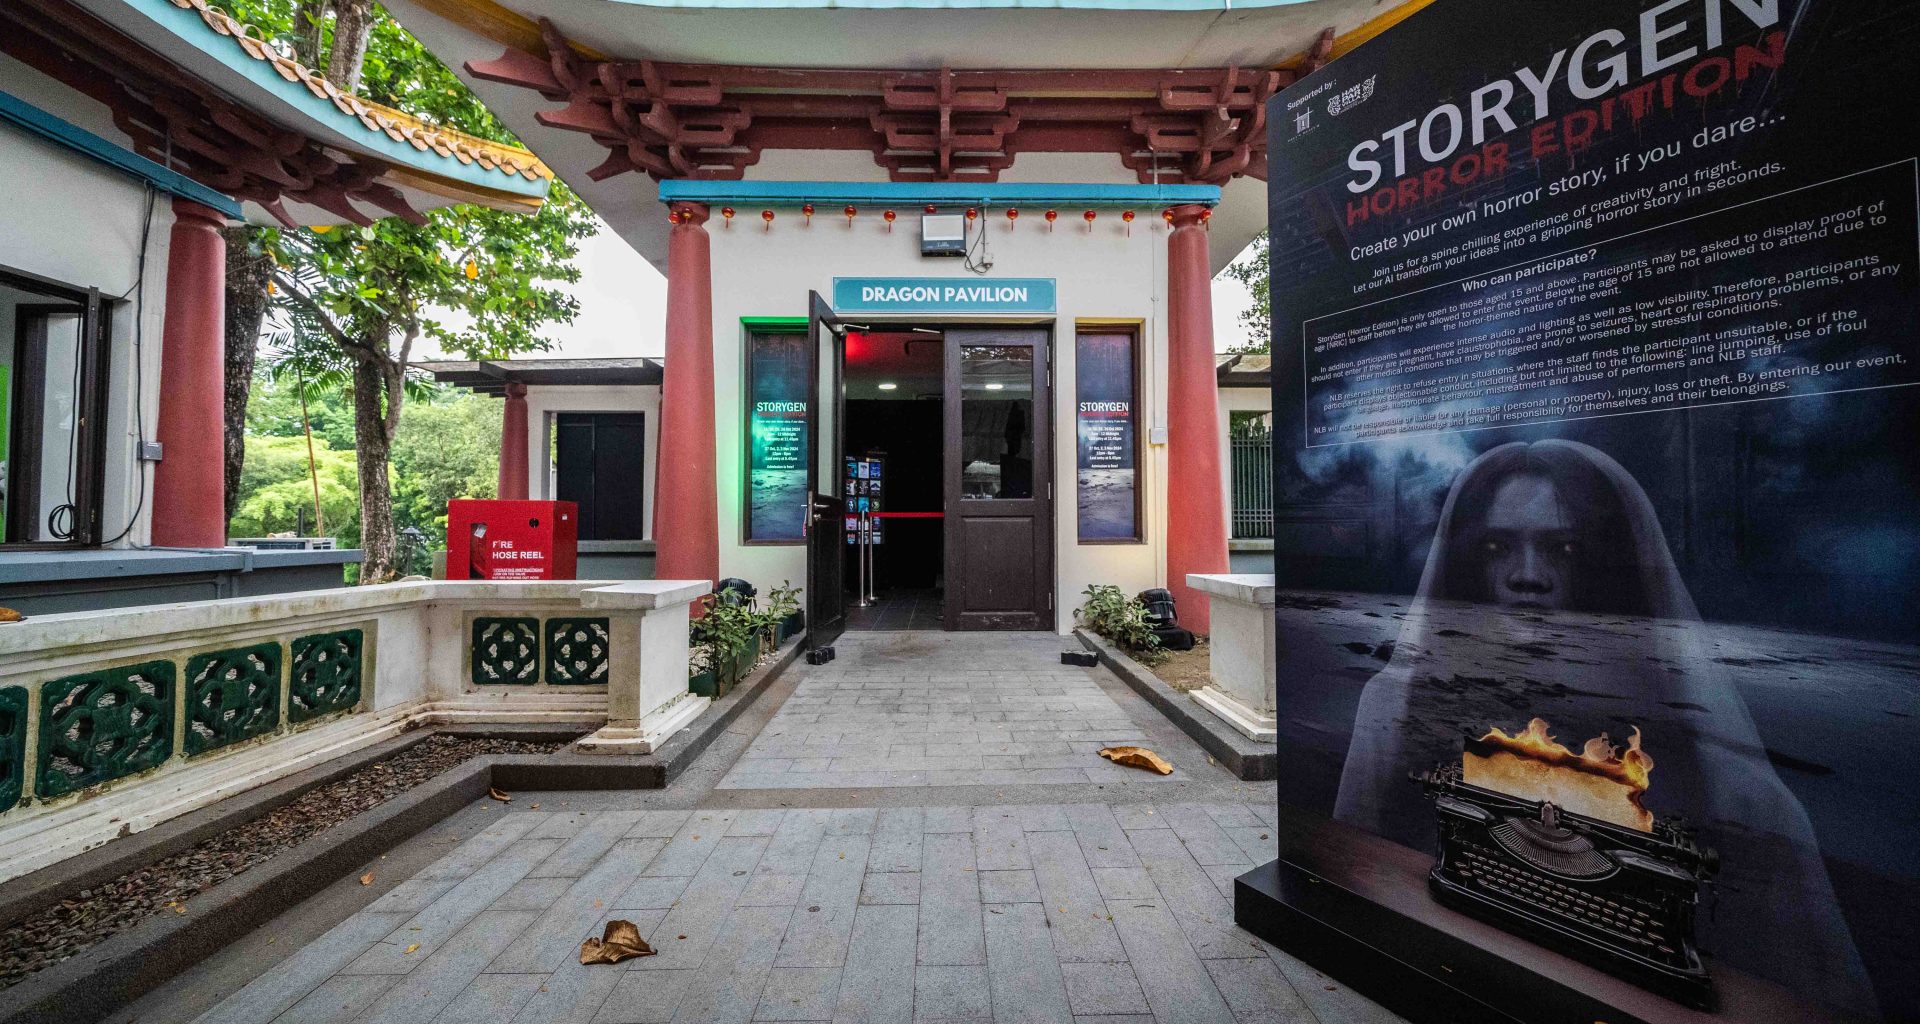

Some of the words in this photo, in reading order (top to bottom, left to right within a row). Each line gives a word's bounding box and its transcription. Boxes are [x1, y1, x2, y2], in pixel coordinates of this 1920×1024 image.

[1287, 85, 1322, 110] Supported
[1324, 81, 1333, 90] by
[1342, 83, 1360, 98] HAW
[1342, 89, 1360, 103] PAR
[1346, 142, 1510, 227] HORROR
[1530, 31, 1786, 162] EDITION
[1351, 236, 1397, 261] Create
[1403, 222, 1437, 248] your
[1442, 209, 1475, 231] own
[1484, 187, 1542, 217] horror
[1549, 167, 1606, 196] story,
[1616, 152, 1629, 174] if
[1638, 140, 1680, 172] you
[1692, 111, 1785, 149] dare...
[1353, 282, 1366, 294] Let
[1368, 279, 1383, 289] our
[1384, 273, 1393, 285] AI
[1396, 262, 1441, 281] transform
[1445, 254, 1467, 270] your
[1470, 245, 1499, 260] ideas
[1503, 237, 1525, 250] into
[1529, 234, 1536, 243] a
[1541, 218, 1592, 242] gripping
[1597, 204, 1639, 223] horror
[1644, 191, 1681, 210] story
[1688, 184, 1700, 197] in
[1707, 161, 1785, 191] seconds.
[1372, 266, 1390, 278] Join
[1393, 263, 1404, 272] us
[1406, 258, 1420, 268] for
[1422, 255, 1428, 263] a
[1431, 246, 1458, 261] spine
[1462, 233, 1500, 251] chilling
[1503, 212, 1568, 239] experience
[1573, 204, 1586, 218] of
[1590, 186, 1654, 212] creativity
[1659, 172, 1688, 192] and
[1694, 158, 1741, 182] fright.
[1317, 332, 1345, 344] StoryGen
[1347, 326, 1370, 339] (Horror
[1372, 318, 1399, 331] Edition)
[1409, 312, 1425, 322] only
[1427, 308, 1446, 319] open
[1460, 299, 1483, 310] those
[1486, 291, 1506, 306] aged
[1511, 287, 1522, 298] 15
[1526, 282, 1543, 295] and
[1547, 277, 1579, 290] above.
[1583, 259, 1647, 281] Participants
[1652, 252, 1676, 265] may
[1680, 247, 1696, 258] be
[1700, 234, 1739, 253] asked
[1744, 233, 1757, 243] to
[1763, 219, 1814, 238] display
[1820, 204, 1862, 228] proof
[1868, 199, 1884, 214] of
[1415, 322, 1427, 330] are
[1429, 312, 1459, 326] allowed
[1473, 306, 1495, 316] enter
[1497, 301, 1511, 311] the
[1514, 294, 1542, 307] event.
[1545, 287, 1574, 300] Below
[1578, 282, 1594, 293] the
[1598, 277, 1617, 289] age
[1621, 271, 1632, 283] of
[1637, 267, 1652, 279] 15
[1656, 264, 1675, 275] are
[1680, 256, 1700, 269] not
[1704, 243, 1754, 264] allowed
[1760, 241, 1774, 251] to
[1779, 226, 1827, 247] attend
[1834, 220, 1864, 234] due
[1870, 215, 1886, 226] to
[1462, 278, 1487, 292] Who
[1490, 273, 1512, 285] can
[1515, 247, 1597, 282] participate?
[862, 287, 940, 302] DRAGON
[945, 287, 1028, 302] PAVILION
[1443, 323, 1456, 332] the
[1458, 307, 1520, 328] horror-themed
[1523, 302, 1553, 314] nature
[1557, 297, 1566, 307] of
[1570, 294, 1586, 304] the
[1589, 286, 1621, 300] event.
[1457, 336, 1524, 355] claustrophobia,
[1526, 333, 1541, 342] are
[1545, 327, 1573, 341] prone
[1576, 324, 1586, 332] to
[1590, 315, 1637, 330] seizures,
[1641, 306, 1672, 320] heart
[1675, 304, 1688, 314] or
[1692, 290, 1763, 311] respiratory
[1768, 275, 1843, 299] problems,
[1849, 270, 1866, 281] or
[1871, 263, 1900, 277] any
[1490, 328, 1515, 340] audio
[1518, 322, 1536, 334] and
[1539, 317, 1575, 331] lighting
[1578, 314, 1590, 322] as
[1594, 306, 1614, 319] well
[1618, 305, 1631, 314] as
[1635, 301, 1654, 311] low
[1658, 290, 1709, 306] visibility.
[1713, 276, 1780, 295] Therefore,
[1785, 255, 1879, 284] participants
[1652, 311, 1702, 329] stressful
[1707, 299, 1782, 319] conditions.
[1715, 320, 1792, 340] unsuitable,
[1797, 317, 1812, 327] or
[1818, 312, 1826, 324] if
[1832, 308, 1857, 322] the
[1720, 335, 1779, 353] jumping,
[1785, 330, 1810, 341] use
[1816, 324, 1831, 336] of
[1837, 318, 1866, 333] foul
[1719, 349, 1745, 362] NLB
[1751, 343, 1786, 357] staff.
[1738, 371, 1754, 384] By
[1760, 364, 1820, 380] entering
[1825, 361, 1851, 372] our
[1856, 352, 1906, 368] event,
[1711, 381, 1789, 397] belongings.
[757, 402, 806, 412] STORYGEN
[1080, 402, 1128, 411] STORYGEN
